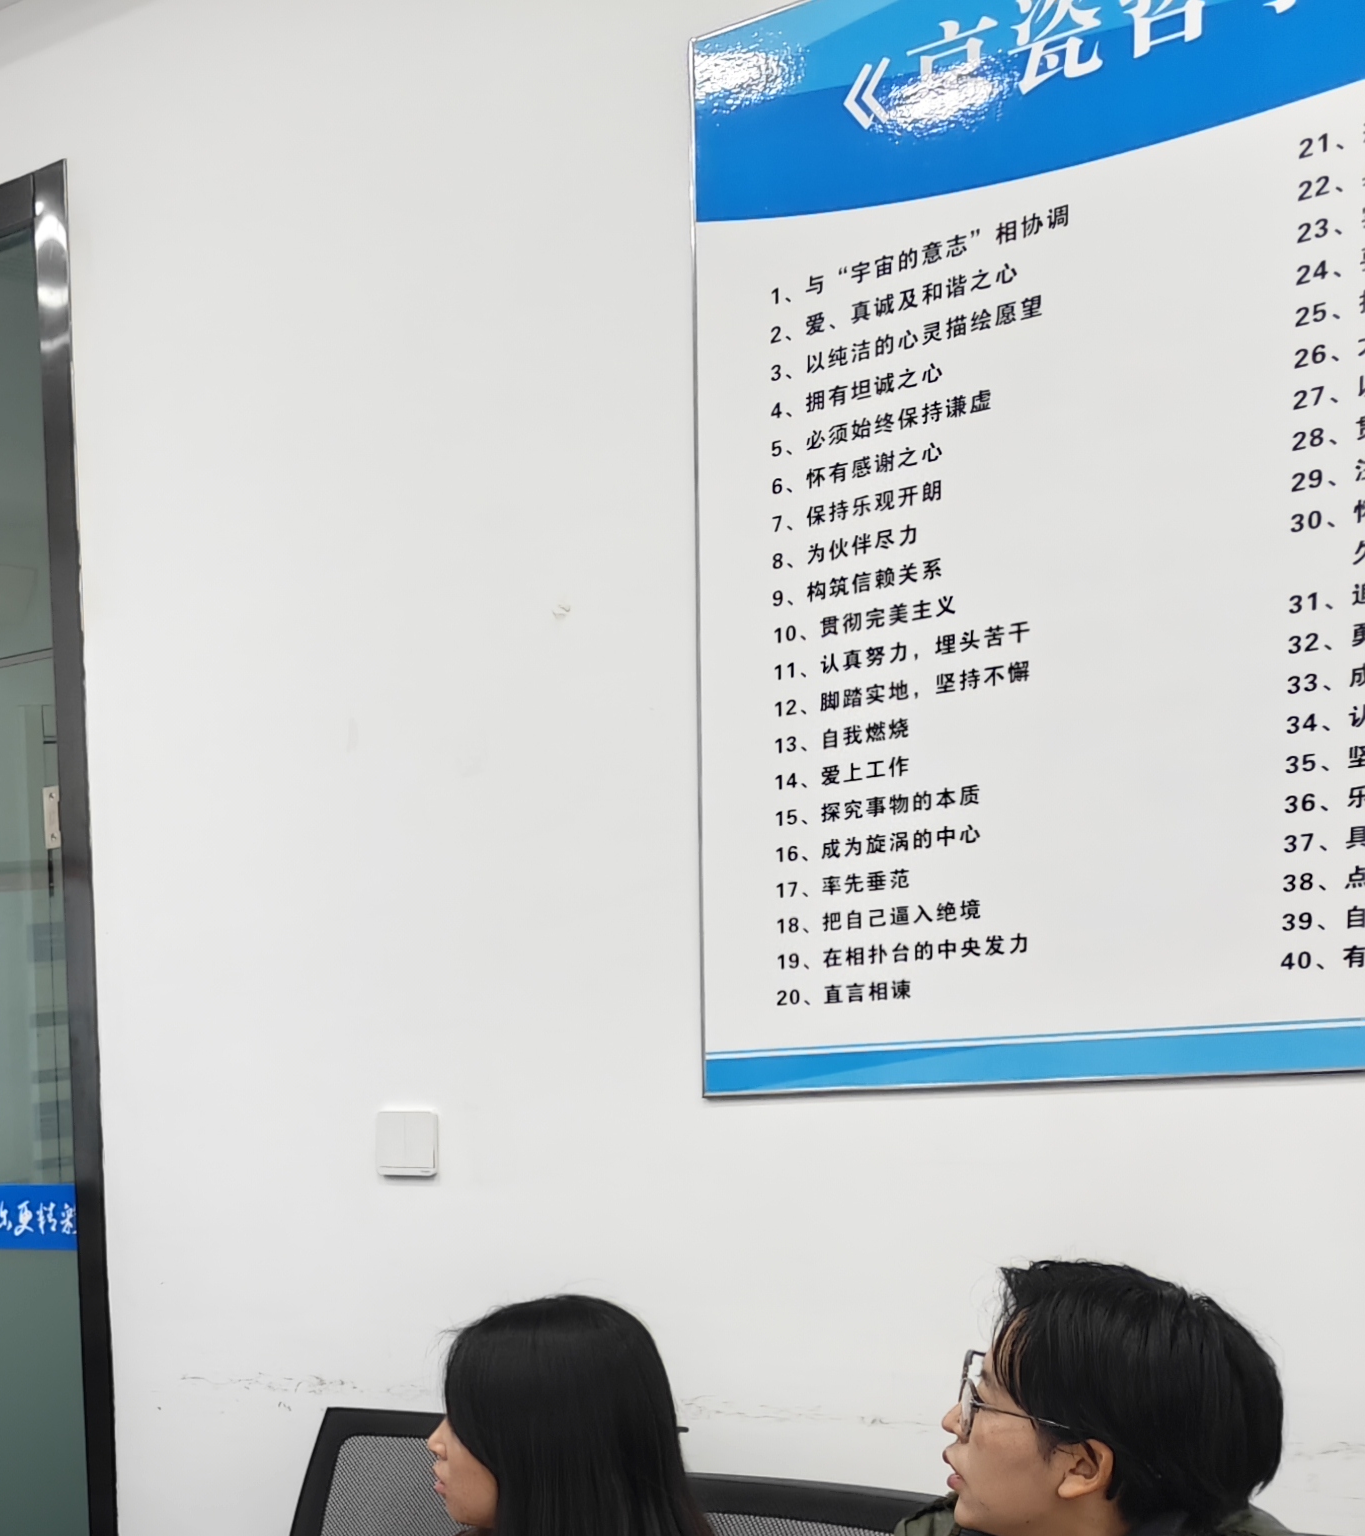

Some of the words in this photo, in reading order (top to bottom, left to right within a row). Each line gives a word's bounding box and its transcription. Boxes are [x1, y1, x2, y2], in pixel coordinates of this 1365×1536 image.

[1298, 130, 1361, 159] 21、
[1297, 174, 1361, 202] 22、
[1298, 208, 1365, 243] 23、
[1296, 253, 1365, 285] 24、
[1296, 290, 1365, 327] 25、
[1295, 339, 1365, 369] 26、
[1293, 376, 1365, 410] 27、
